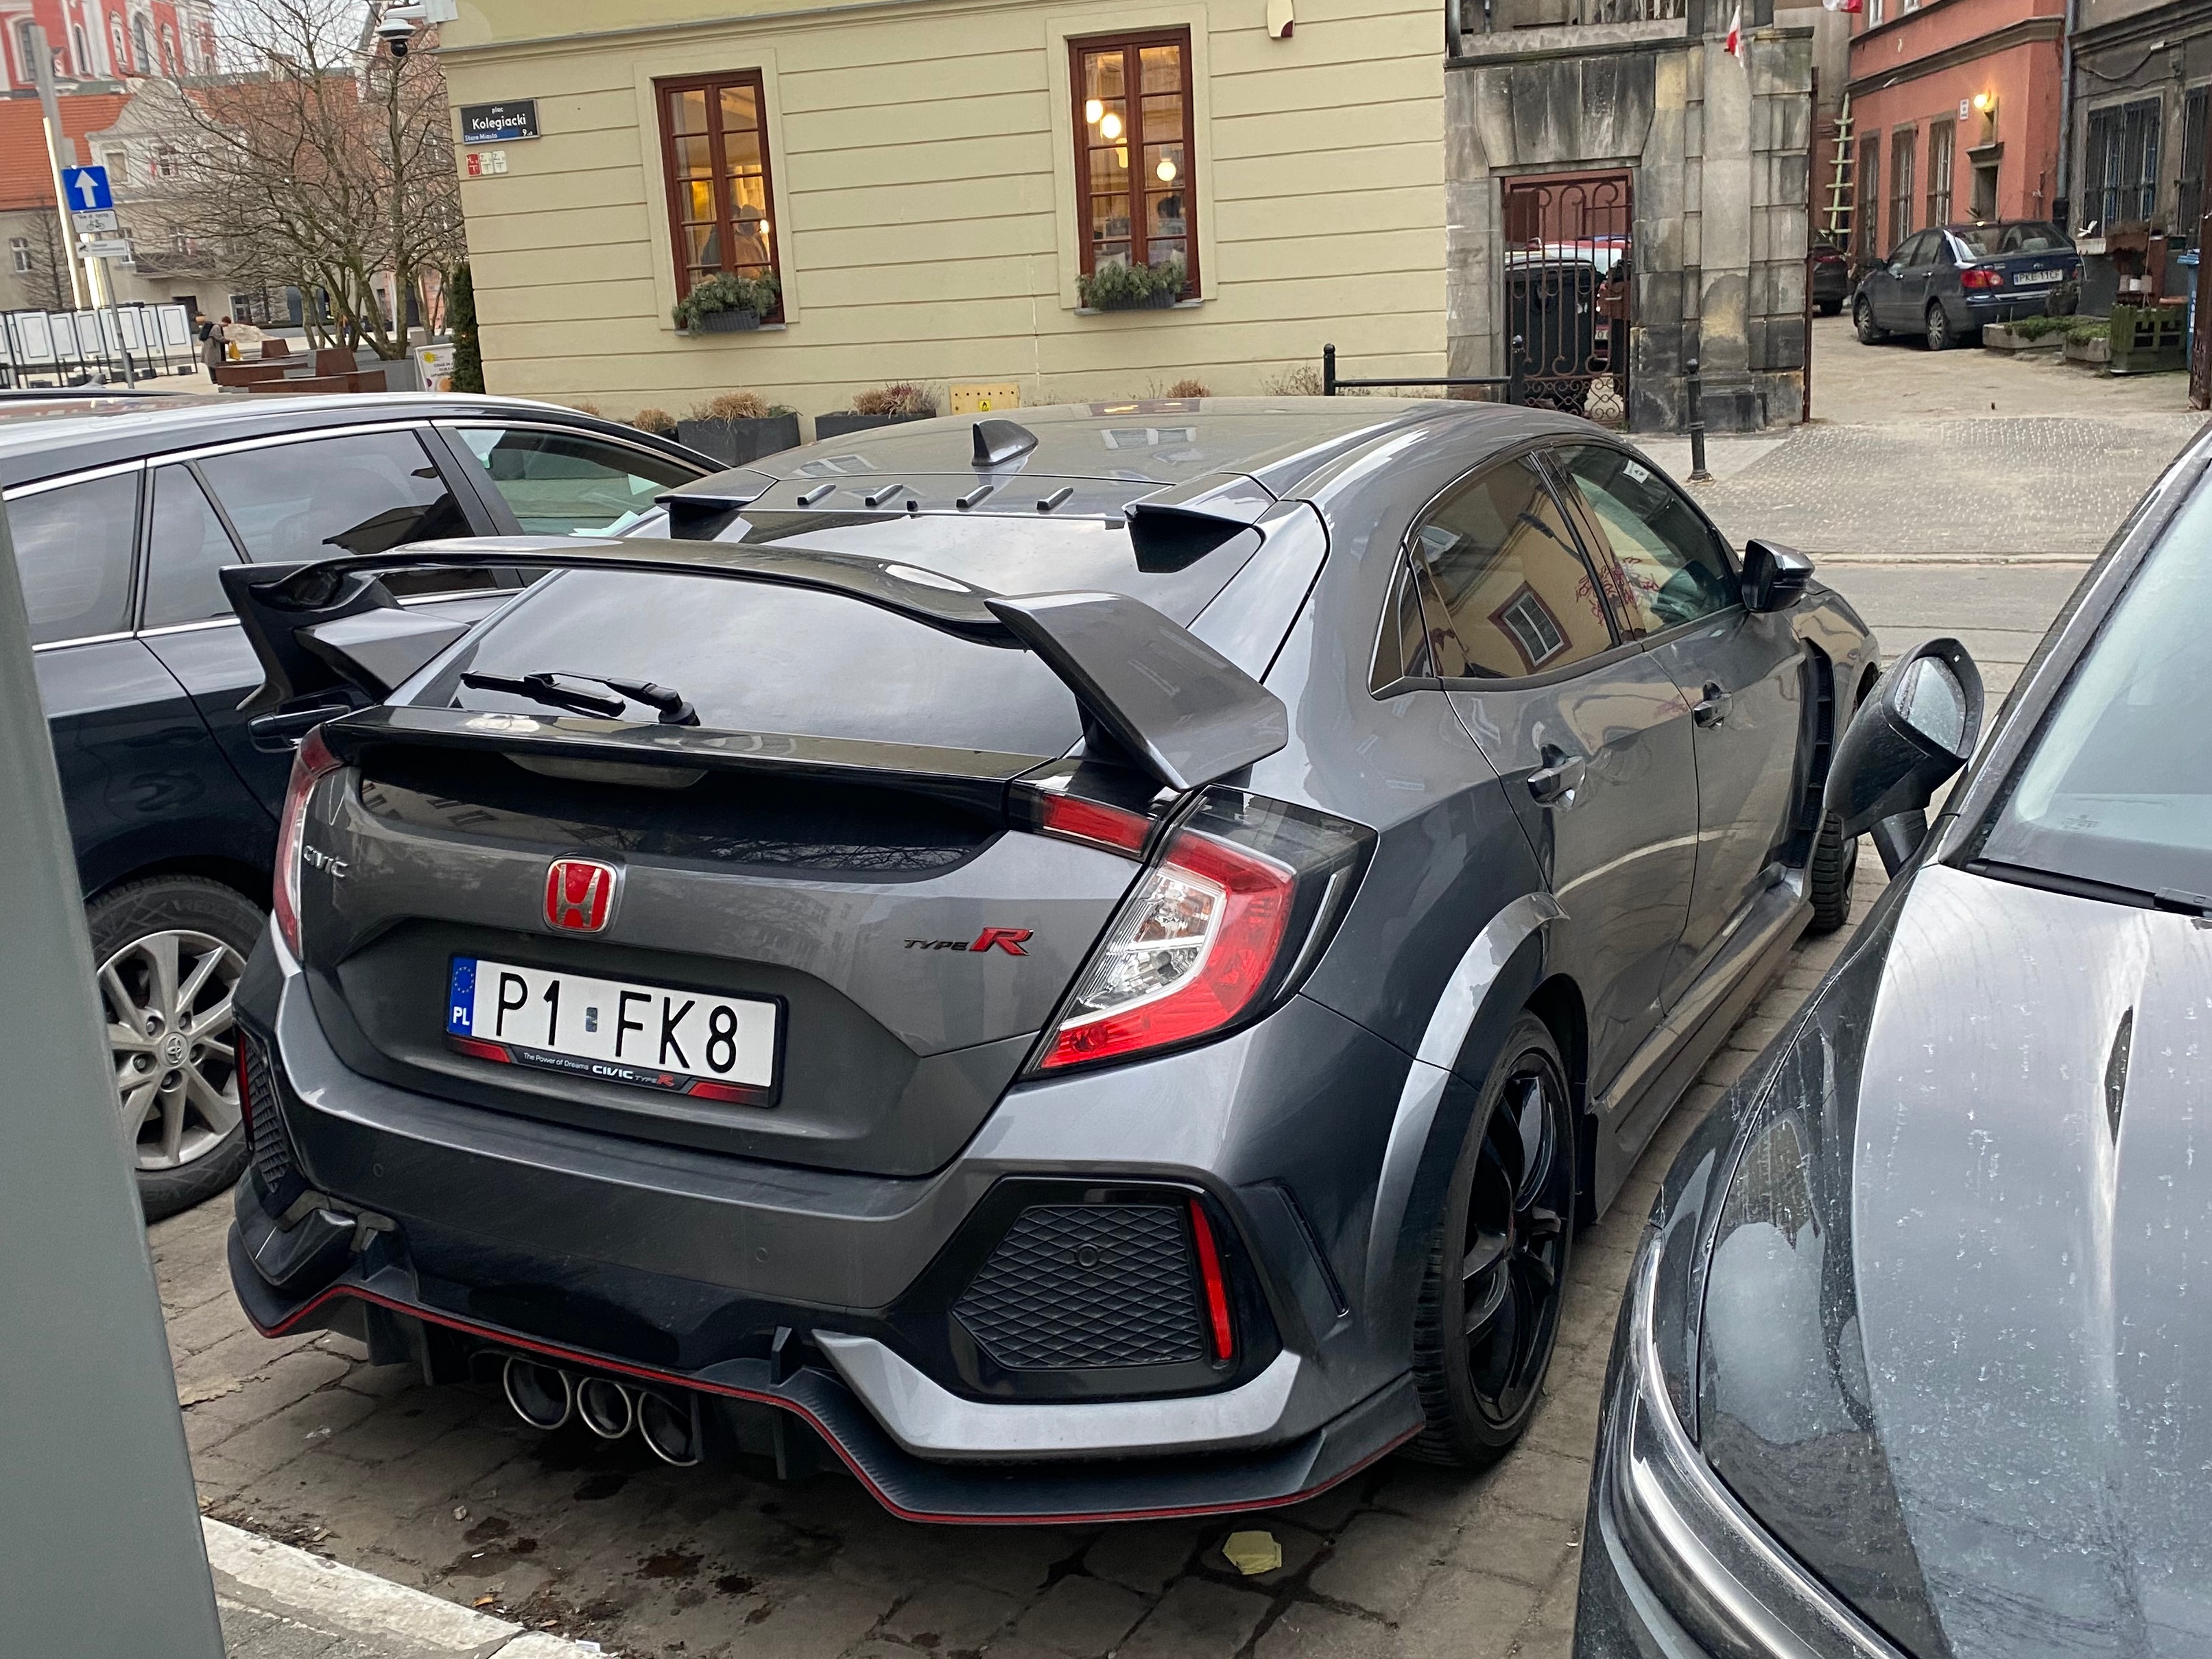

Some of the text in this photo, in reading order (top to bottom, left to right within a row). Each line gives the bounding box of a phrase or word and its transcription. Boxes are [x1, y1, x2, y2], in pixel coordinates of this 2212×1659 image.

[472, 113, 526, 130] Kolegiacki
[302, 845, 348, 877] CIVIC
[904, 927, 1034, 956] TYPE R
[453, 1007, 470, 1026] PL
[496, 972, 738, 1073] P1 FK8
[523, 1052, 534, 1060] The
[536, 1055, 555, 1064] Power
[564, 1060, 588, 1071] Dreams
[592, 1065, 634, 1079] CIVIC
[635, 1075, 657, 1084] TYPE
